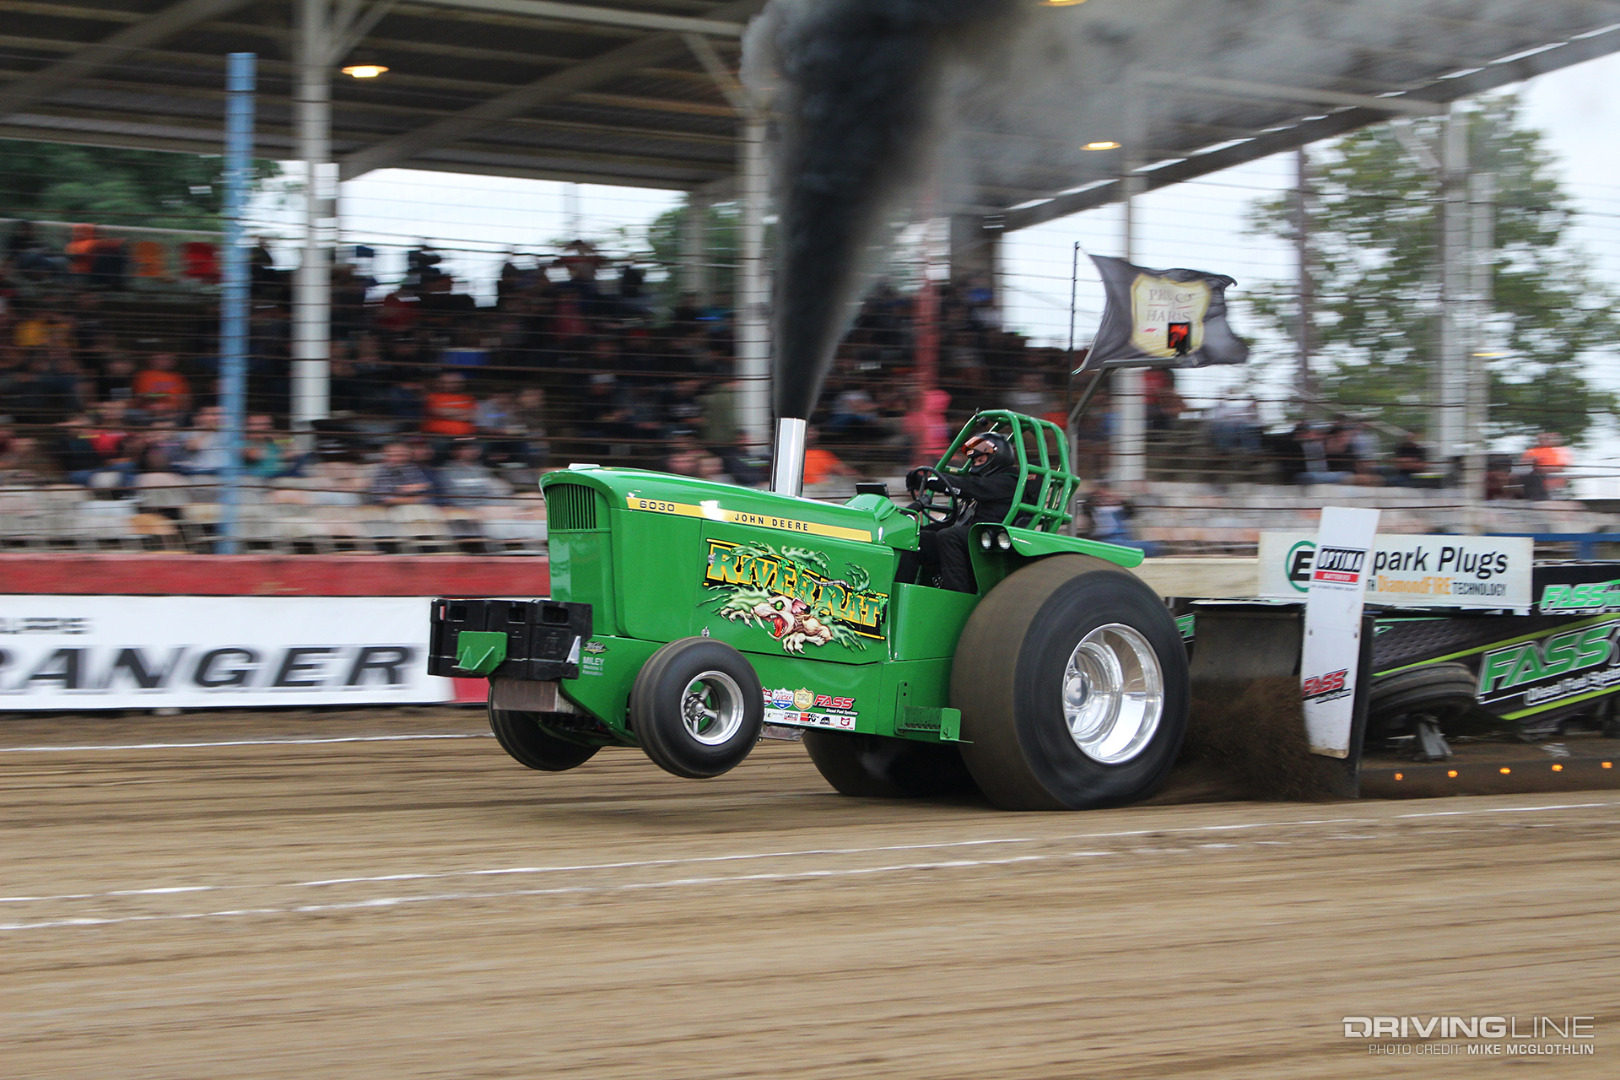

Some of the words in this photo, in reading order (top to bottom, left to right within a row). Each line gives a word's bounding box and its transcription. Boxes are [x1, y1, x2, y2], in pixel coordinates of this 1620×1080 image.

[639, 500, 676, 512] 6030
[734, 513, 764, 525] JOHN
[772, 518, 809, 531] DEERE
[1316, 548, 1364, 573] OPTIMA
[1438, 546, 1508, 579] Plugs
[1378, 574, 1452, 595] DiamondFIRE
[1453, 581, 1507, 597] TECHNOLOGY
[1540, 584, 1608, 609] FASS
[583, 656, 605, 666] MILEY
[1477, 623, 1613, 696] FASS
[1302, 669, 1348, 698] FASS
[813, 694, 855, 710] FASS
